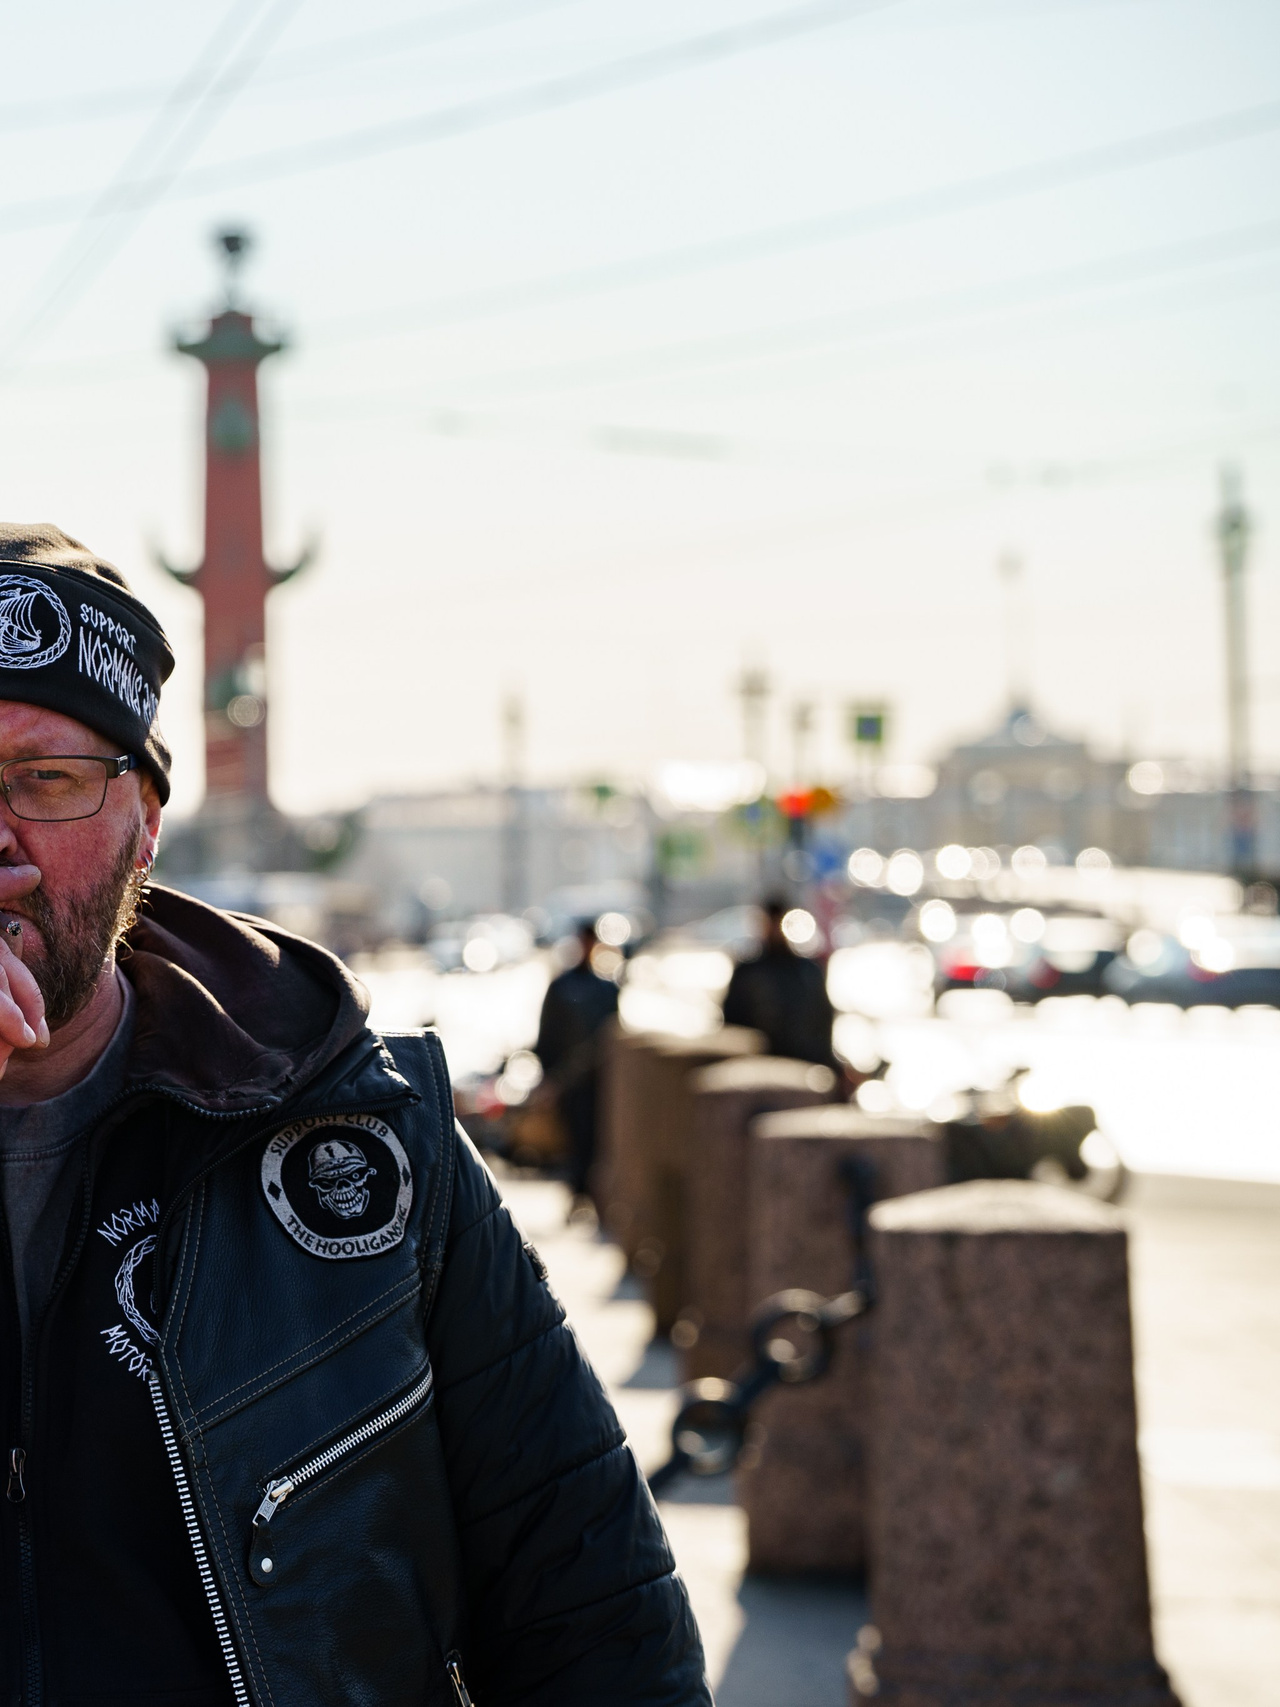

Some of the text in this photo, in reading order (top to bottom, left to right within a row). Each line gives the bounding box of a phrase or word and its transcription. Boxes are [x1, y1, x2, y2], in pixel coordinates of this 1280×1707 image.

[80, 603, 137, 655] SUPPORT
[79, 626, 143, 716] NORMANS
[270, 1114, 388, 1156] SUPPORT CLUB
[286, 1214, 315, 1247] THE
[315, 1222, 403, 1255] HOOLIGANS
